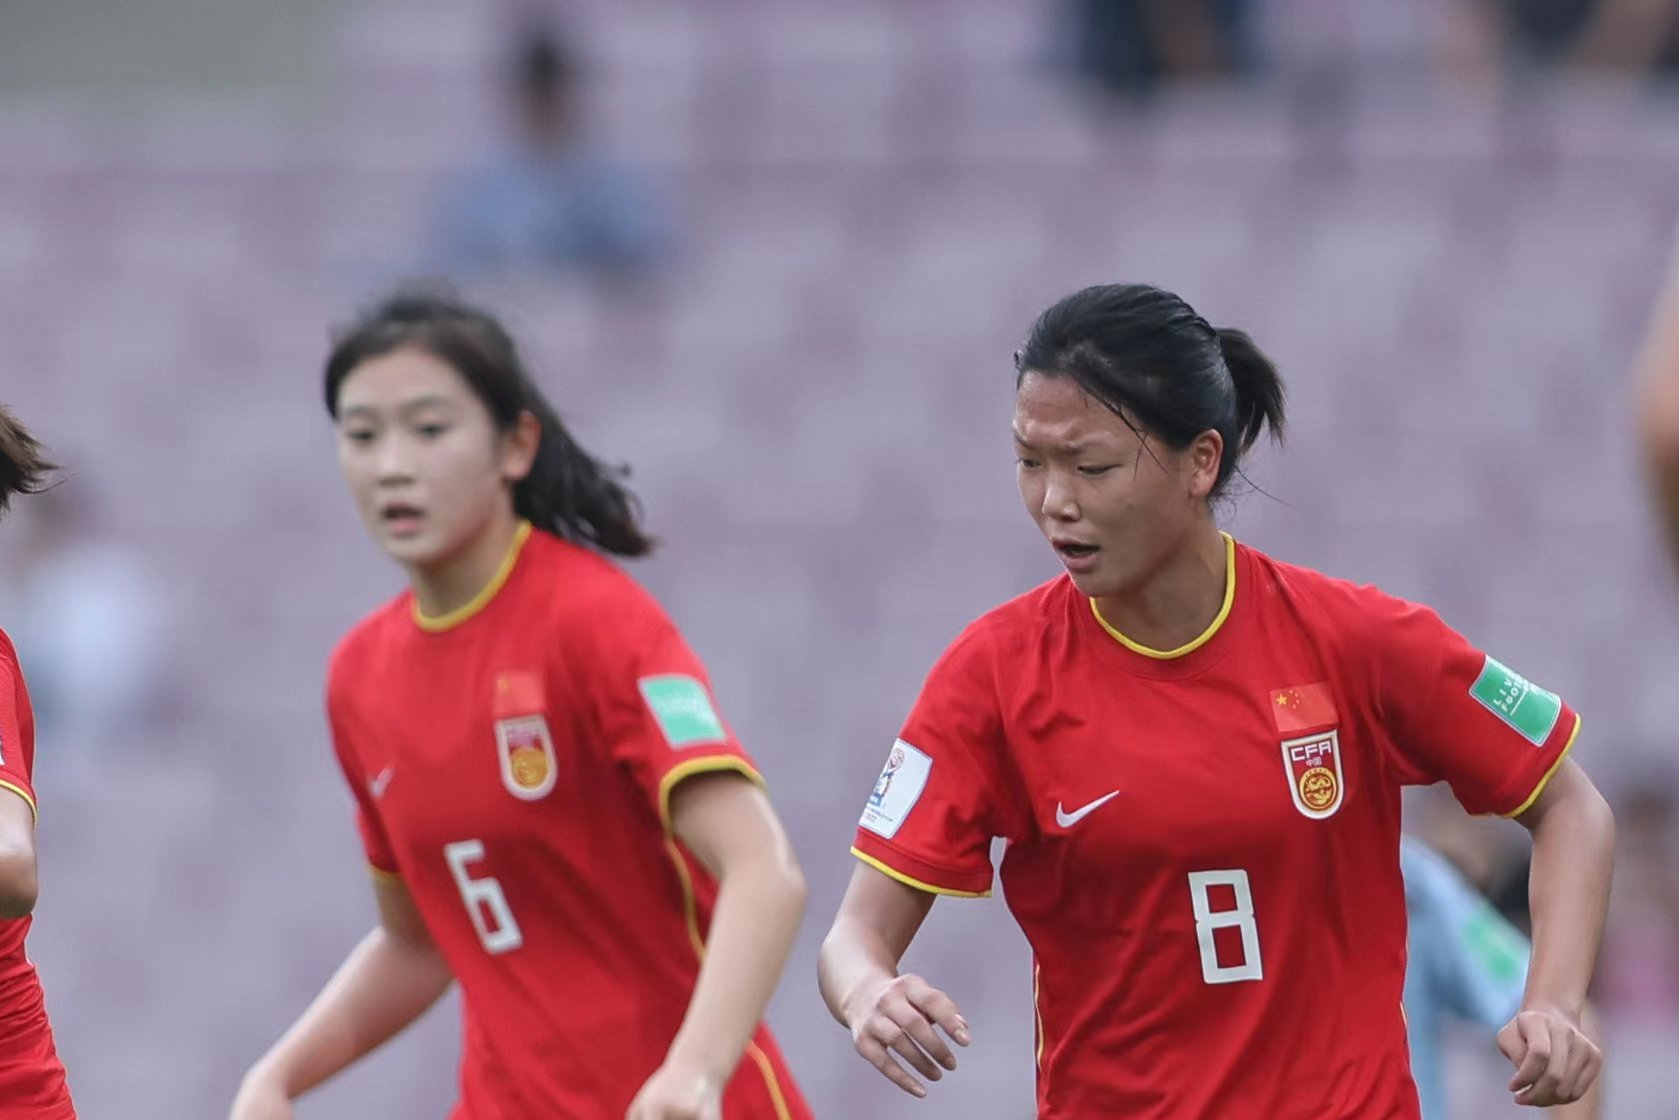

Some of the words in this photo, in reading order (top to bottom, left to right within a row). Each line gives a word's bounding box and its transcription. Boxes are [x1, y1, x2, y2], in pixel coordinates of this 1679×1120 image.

[1290, 740, 1332, 762] CFA
[443, 841, 523, 955] 6
[1188, 869, 1263, 985] 8
